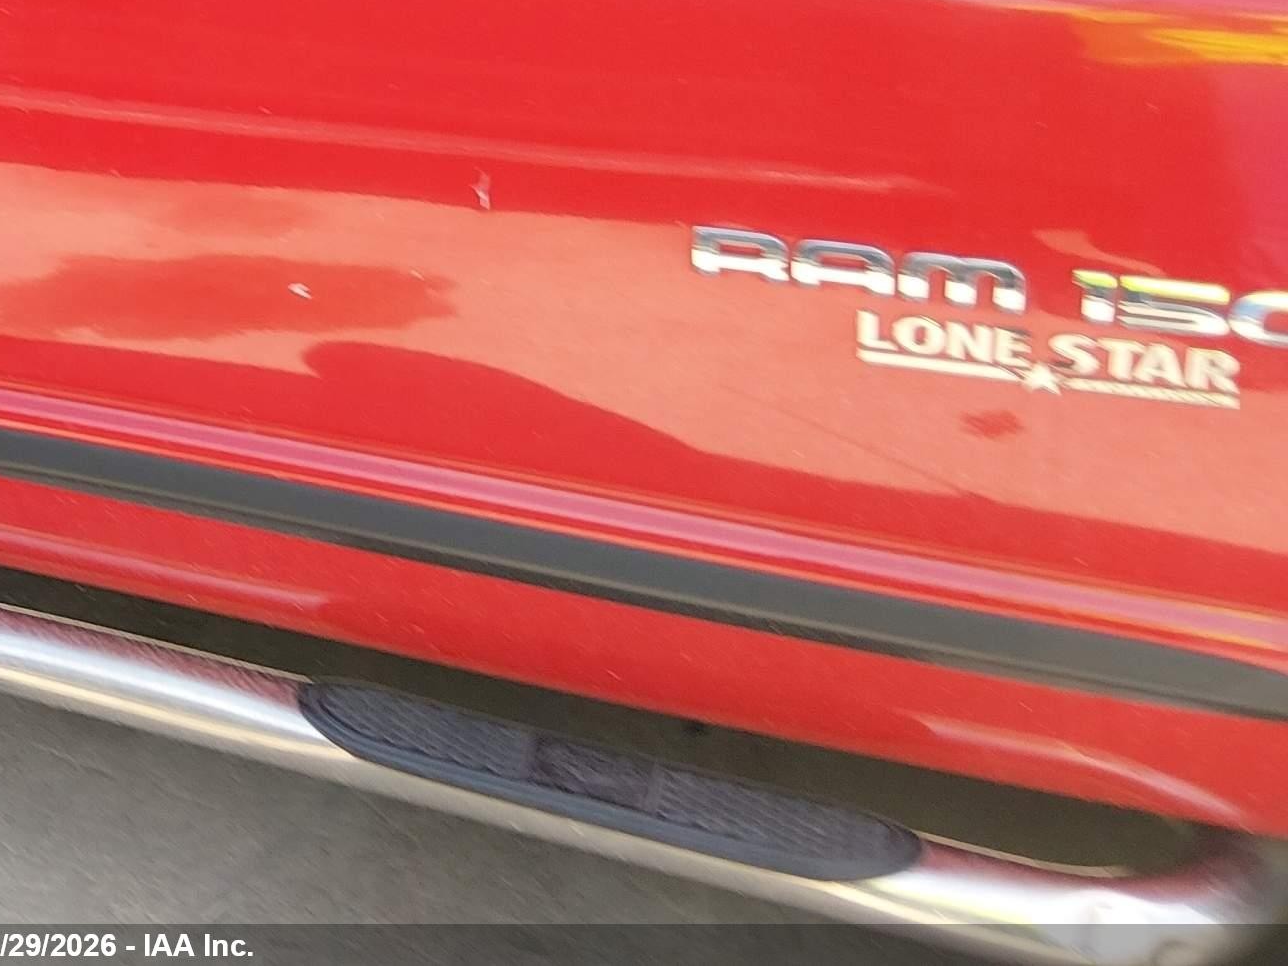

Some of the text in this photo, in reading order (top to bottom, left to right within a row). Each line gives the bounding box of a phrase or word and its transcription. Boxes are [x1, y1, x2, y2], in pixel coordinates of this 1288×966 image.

[691, 225, 1026, 312] RAM
[856, 310, 1241, 394] LONE STAR
